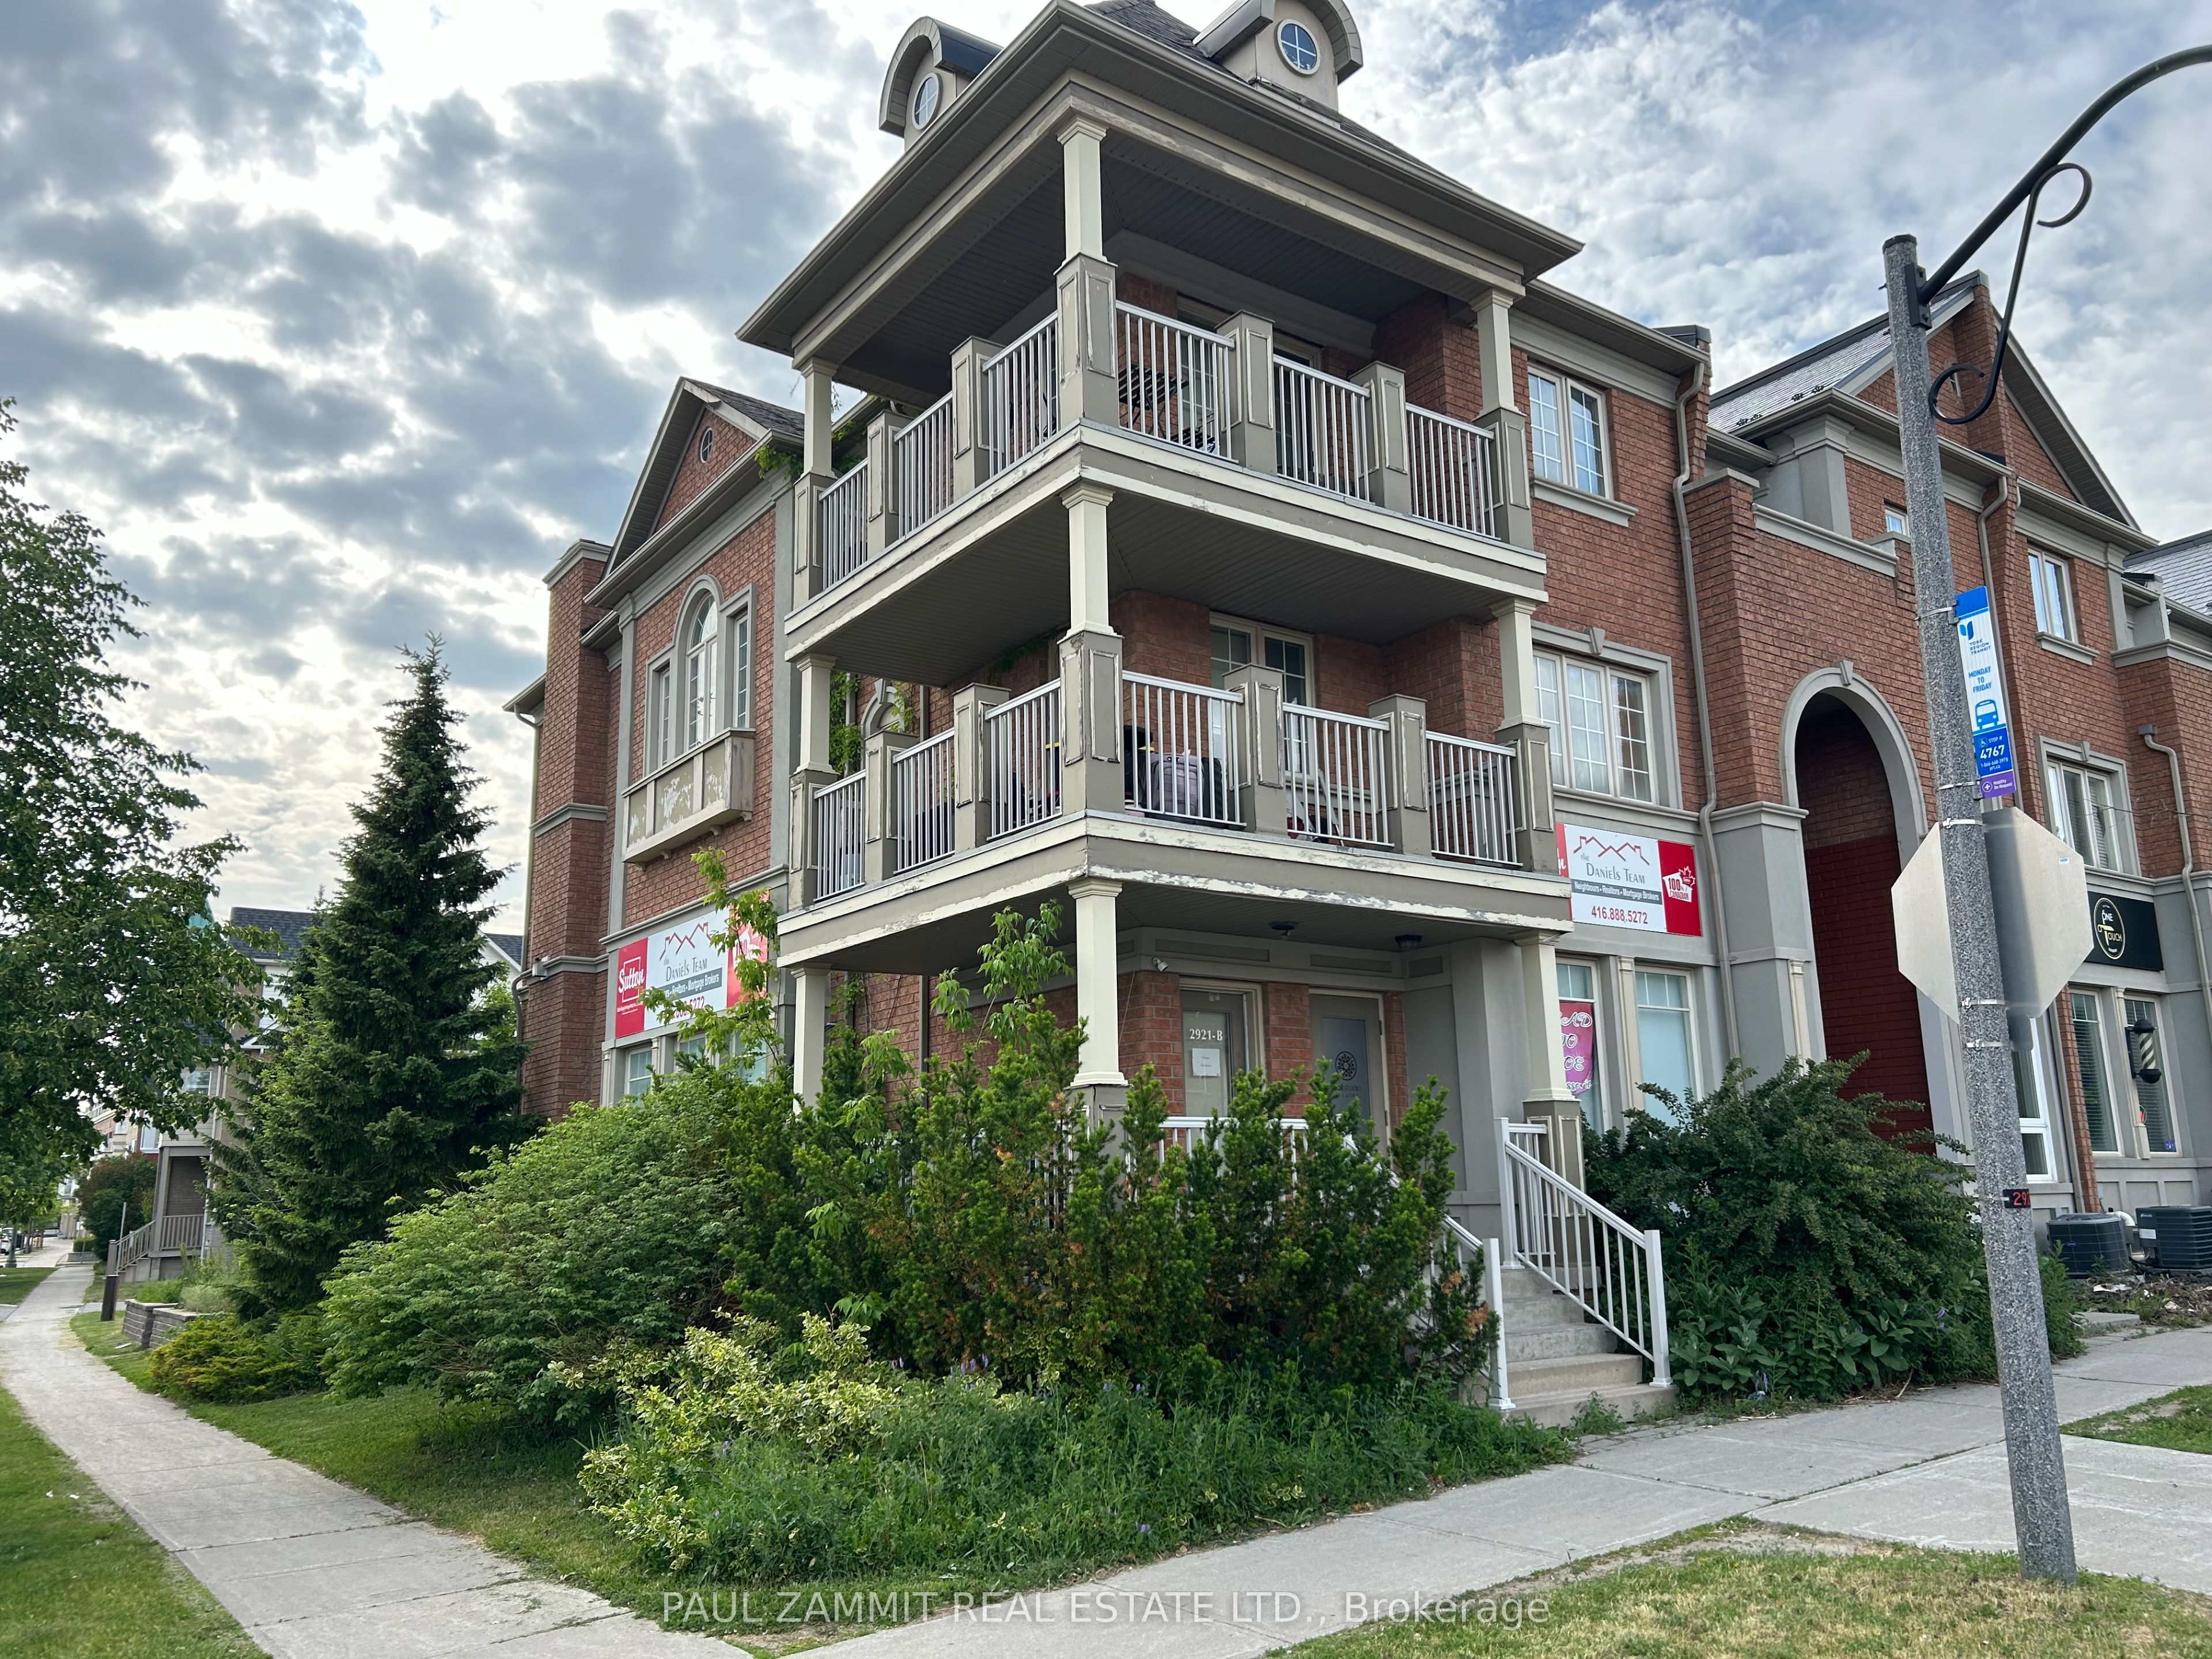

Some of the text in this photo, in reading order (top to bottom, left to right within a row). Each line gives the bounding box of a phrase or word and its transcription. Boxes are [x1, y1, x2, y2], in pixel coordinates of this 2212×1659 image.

[1970, 642, 1988, 651] REGION
[1971, 646, 1991, 655] TRANSIT
[1968, 666, 1991, 678] MONDAY
[1973, 682, 1991, 693] FRIDAY
[1980, 744, 2005, 759] 4767
[1574, 881, 1659, 900] Neighbours Realtors Mortgage Brokers
[1592, 906, 1648, 924] 416.888.5272
[2101, 911, 2113, 923] ONE
[2097, 925, 2122, 946] TOUCH
[619, 967, 645, 993] Sutton
[688, 978, 704, 991] Mortgage
[704, 973, 719, 986] Brokers
[1190, 1028, 1223, 1041] 2921-B
